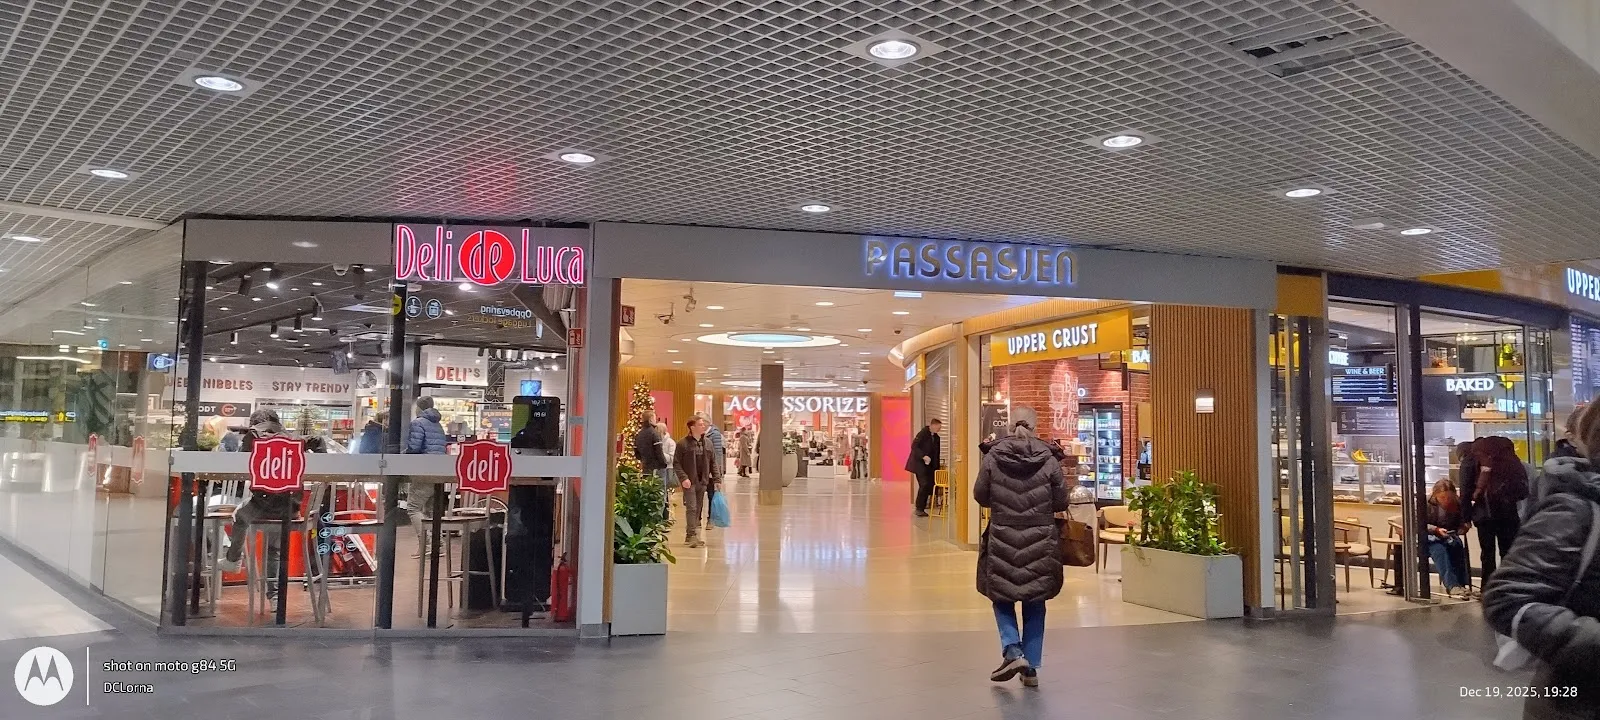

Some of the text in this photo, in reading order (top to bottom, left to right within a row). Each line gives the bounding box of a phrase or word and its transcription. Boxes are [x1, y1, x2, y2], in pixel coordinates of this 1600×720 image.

[395, 225, 453, 281] Deli
[521, 228, 584, 284] Luca
[866, 240, 1078, 284] PASSASJEN
[1567, 267, 1600, 301] UPPER
[1008, 323, 1098, 355] UPPER CRUST
[1133, 349, 1150, 363] BA
[203, 378, 253, 391] NIBBLES
[436, 366, 480, 381] DELI'S
[1446, 378, 1494, 391] BAKED
[272, 381, 349, 394] STAY TRENDY
[727, 396, 868, 413] ACSSORIZE
[260, 446, 293, 480] deli
[466, 449, 500, 482] deli
